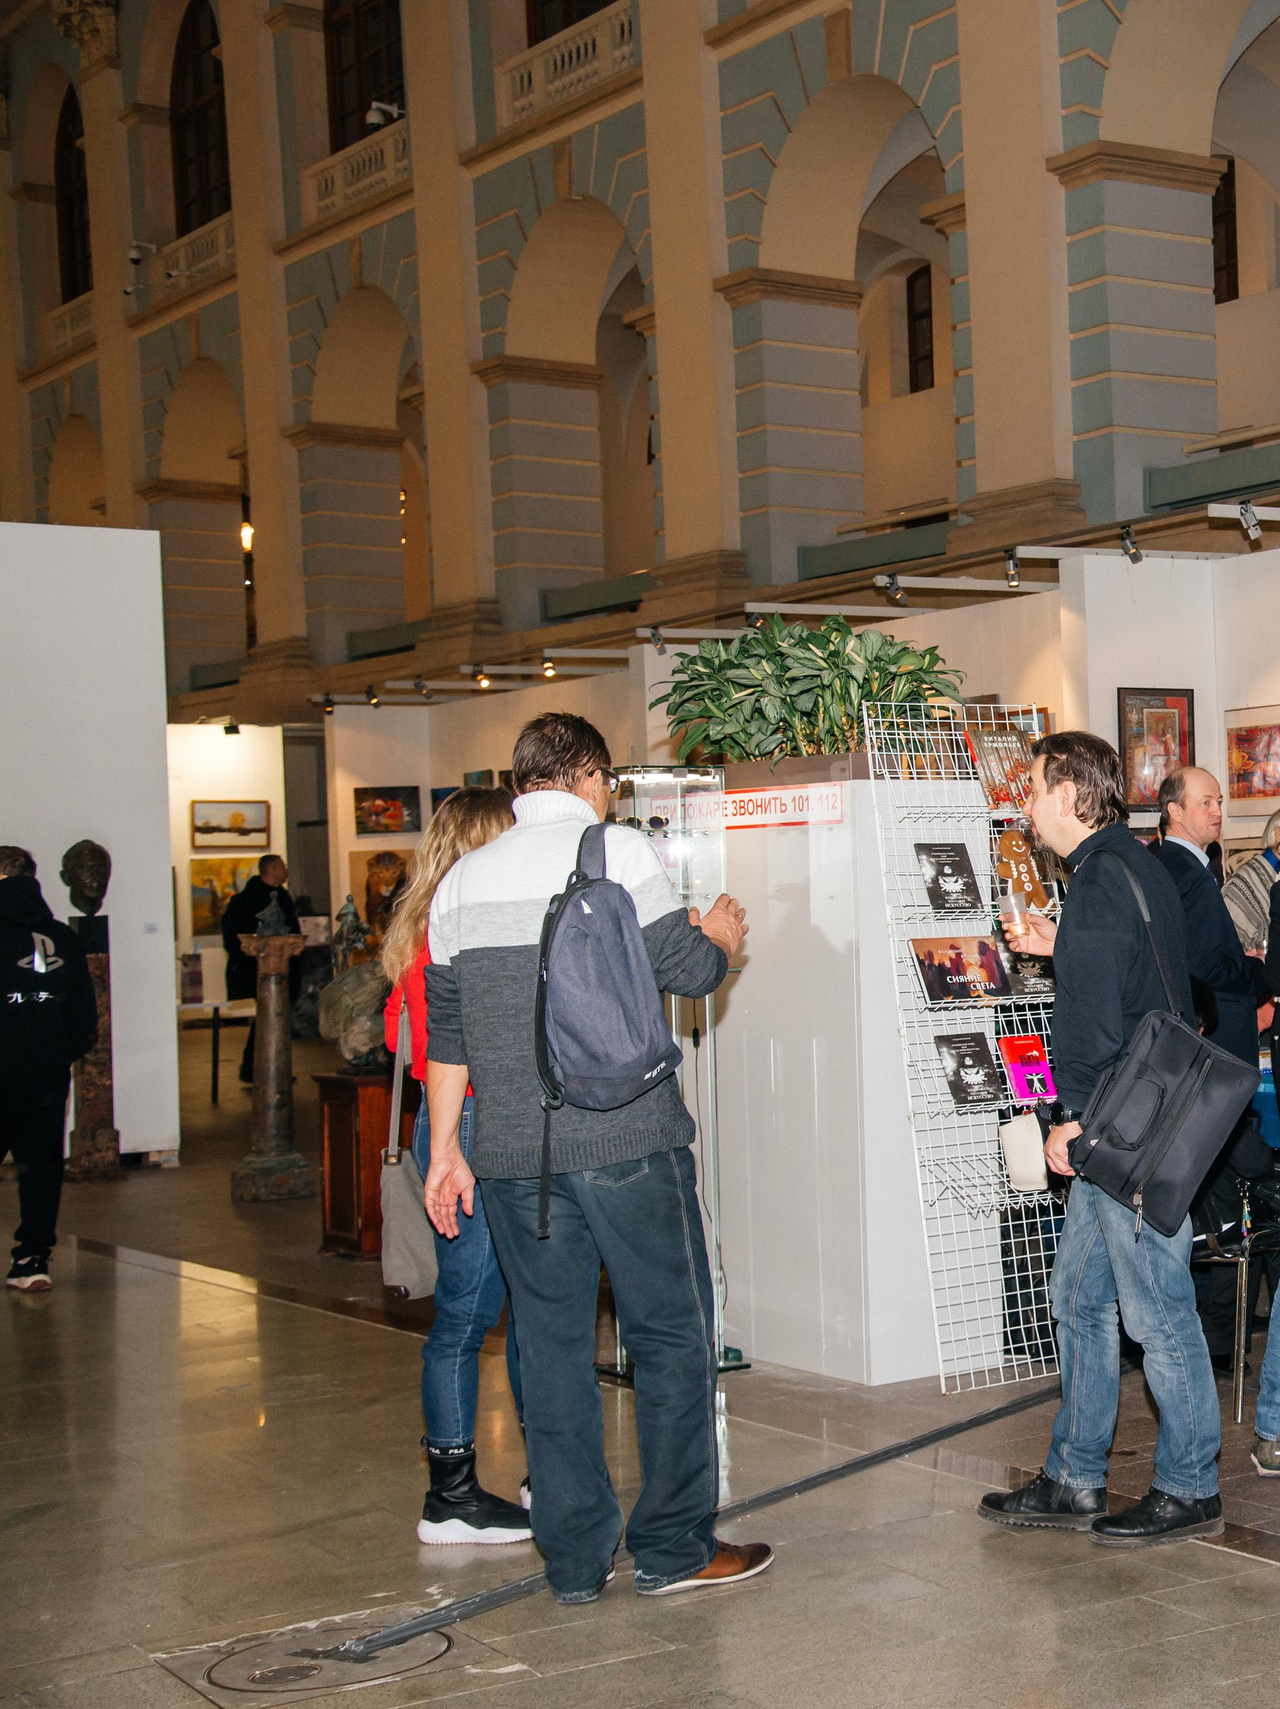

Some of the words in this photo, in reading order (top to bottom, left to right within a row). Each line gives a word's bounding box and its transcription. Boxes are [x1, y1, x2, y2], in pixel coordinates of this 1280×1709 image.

[655, 803, 677, 820] ПРИ
[681, 801, 728, 820] ПОЖАРЕ
[731, 796, 788, 817] ЗВОНИТЬ
[819, 792, 838, 811] 112
[946, 975, 982, 984] СИЯНИЕ
[970, 982, 996, 990] СВЕТА
